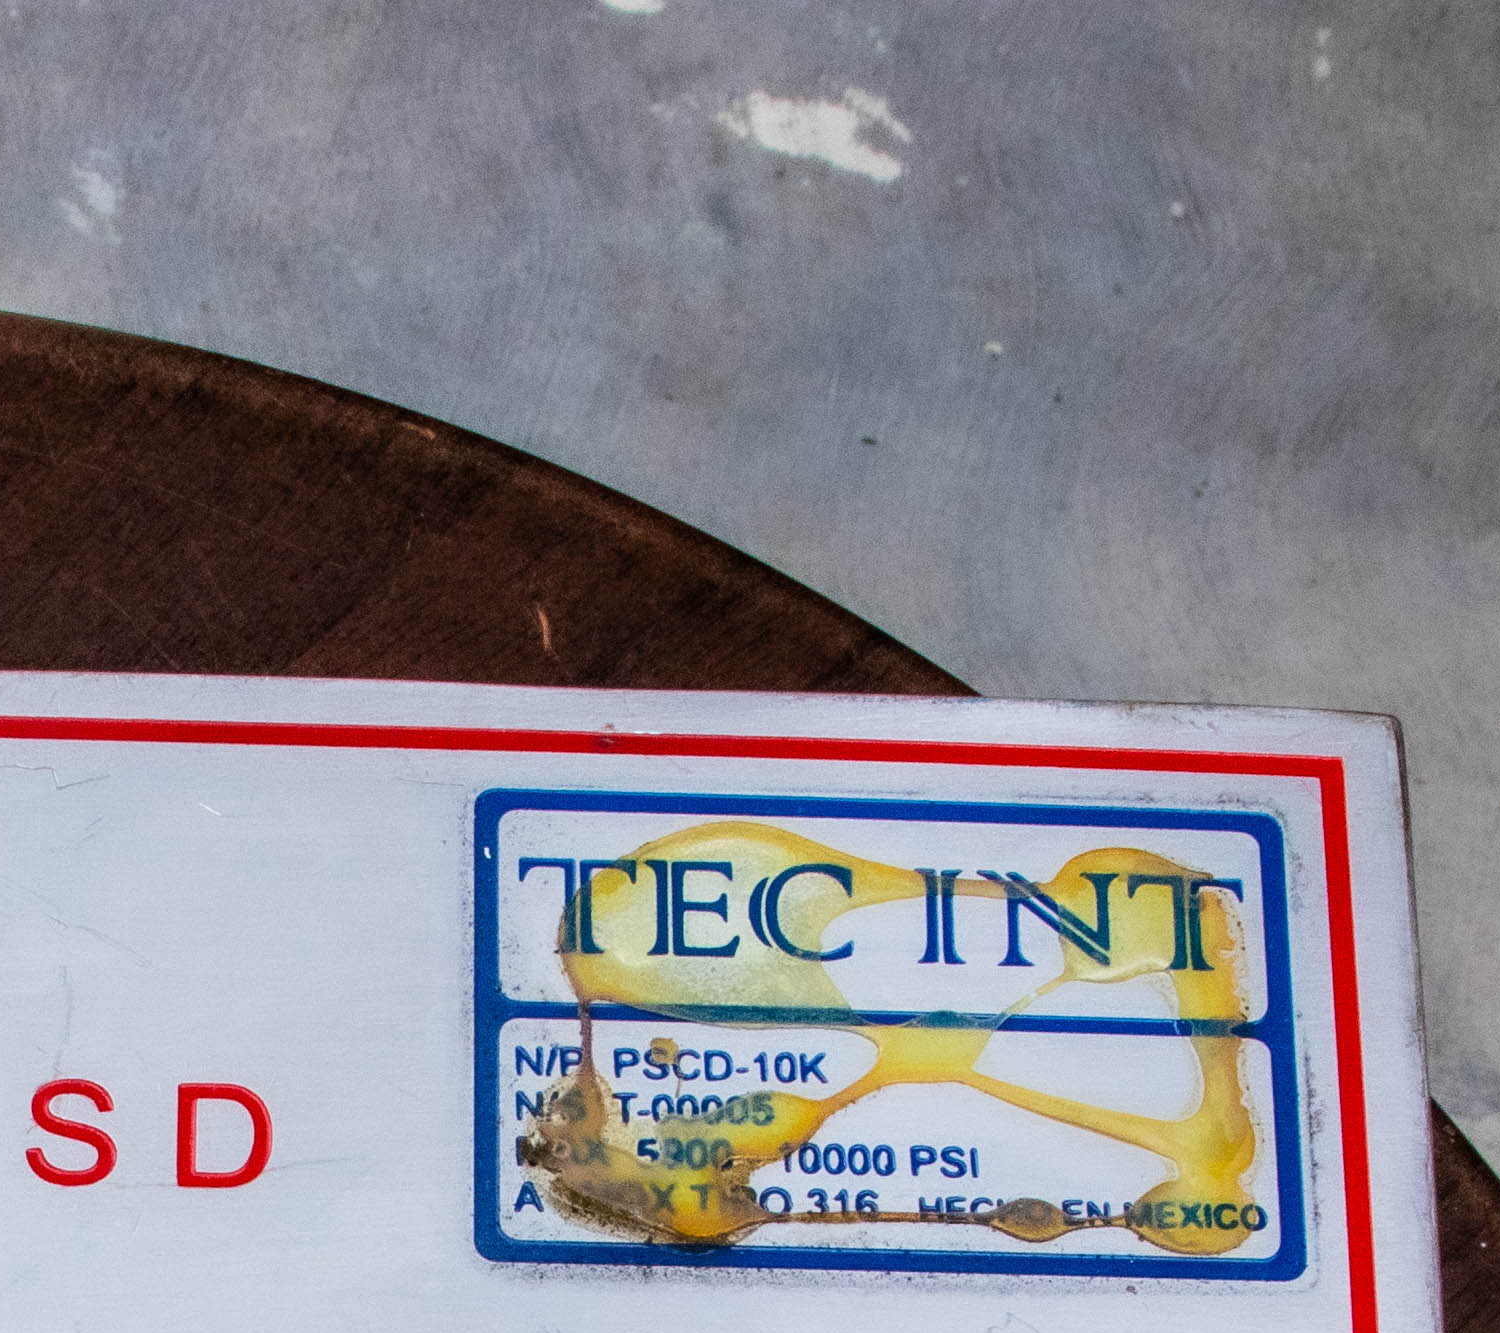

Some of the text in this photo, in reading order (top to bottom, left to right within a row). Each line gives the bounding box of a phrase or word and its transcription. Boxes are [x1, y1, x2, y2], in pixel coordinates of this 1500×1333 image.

[518, 856, 1244, 972] TEC INT
[612, 1046, 829, 1084] PSCD-10K
[910, 1145, 980, 1179] PSI
[806, 1187, 879, 1220] 316
[1063, 1198, 1112, 1227] EN
[1124, 1199, 1269, 1233] MEXICO
